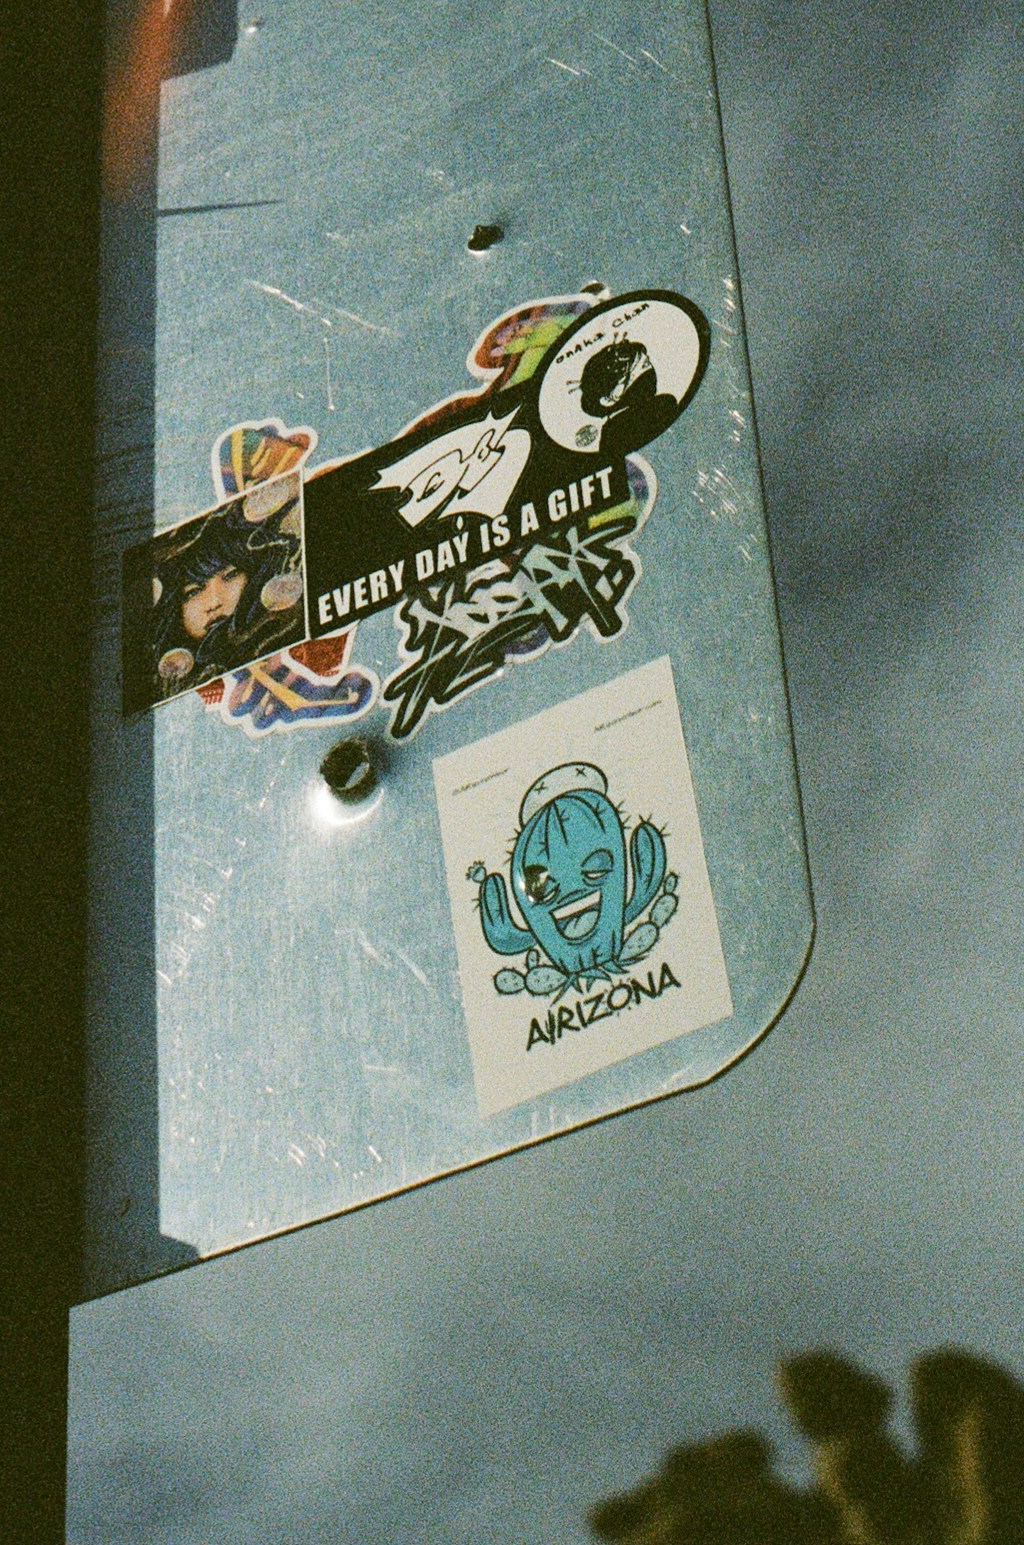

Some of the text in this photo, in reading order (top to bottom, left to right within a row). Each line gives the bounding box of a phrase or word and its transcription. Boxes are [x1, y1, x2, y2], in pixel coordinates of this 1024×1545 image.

[612, 304, 649, 328] Chan
[318, 468, 613, 625] EVERY DAY IS A GIFT
